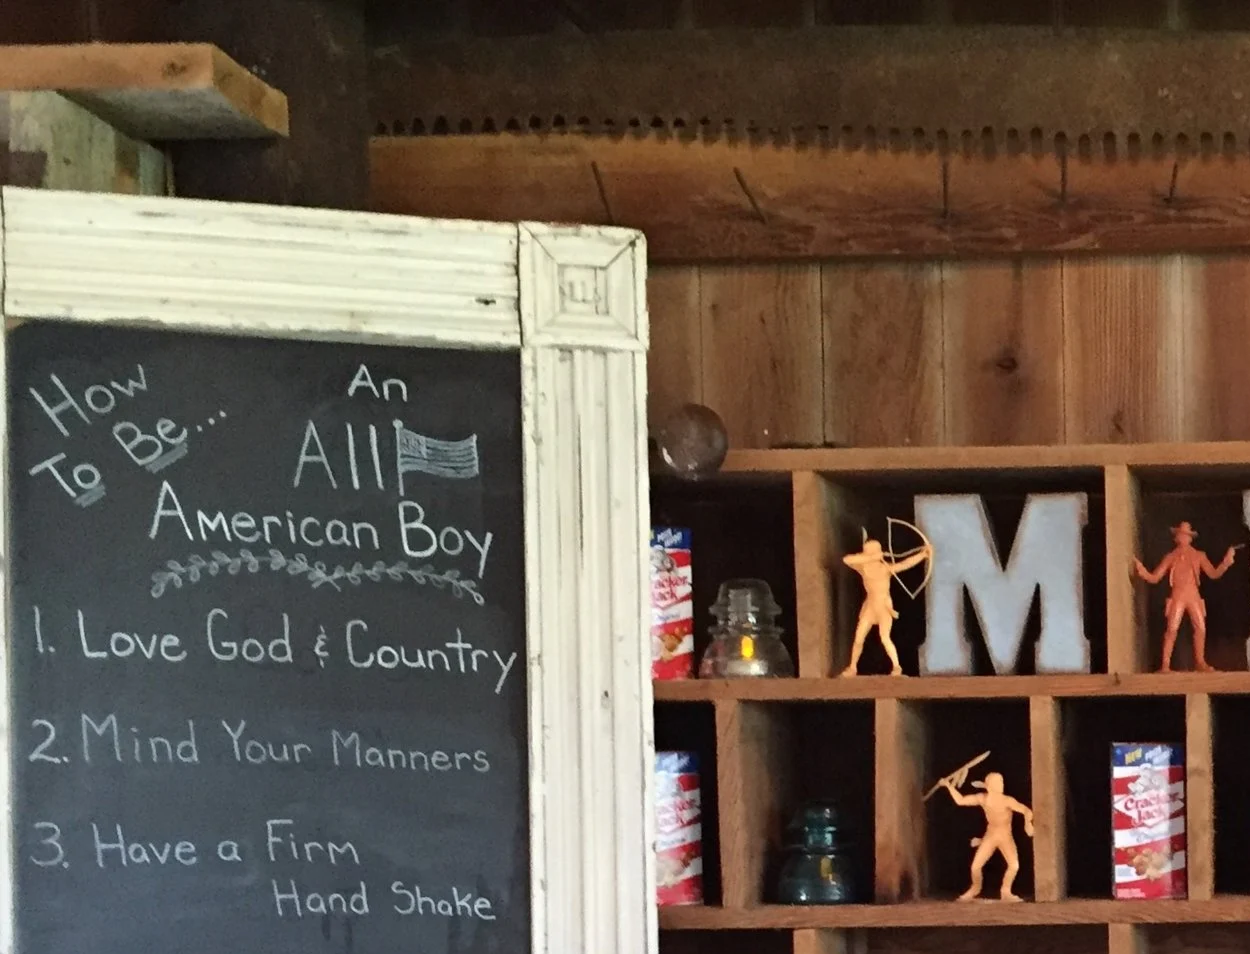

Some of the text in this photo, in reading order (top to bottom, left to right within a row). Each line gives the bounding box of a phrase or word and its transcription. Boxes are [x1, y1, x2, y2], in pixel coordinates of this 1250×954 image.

[29, 363, 149, 437] How
[348, 363, 408, 401] An
[29, 452, 102, 498] To
[294, 418, 385, 490] All
[148, 480, 493, 578] American Boy
[77, 609, 187, 661] Love
[207, 608, 293, 663] God
[347, 620, 517, 694] Country
[28, 713, 490, 773] 2. Mind Your Manners
[1124, 792, 1179, 811] Cracker
[30, 819, 360, 869] 3. Have a Firm
[271, 880, 497, 921] Hand Shake
